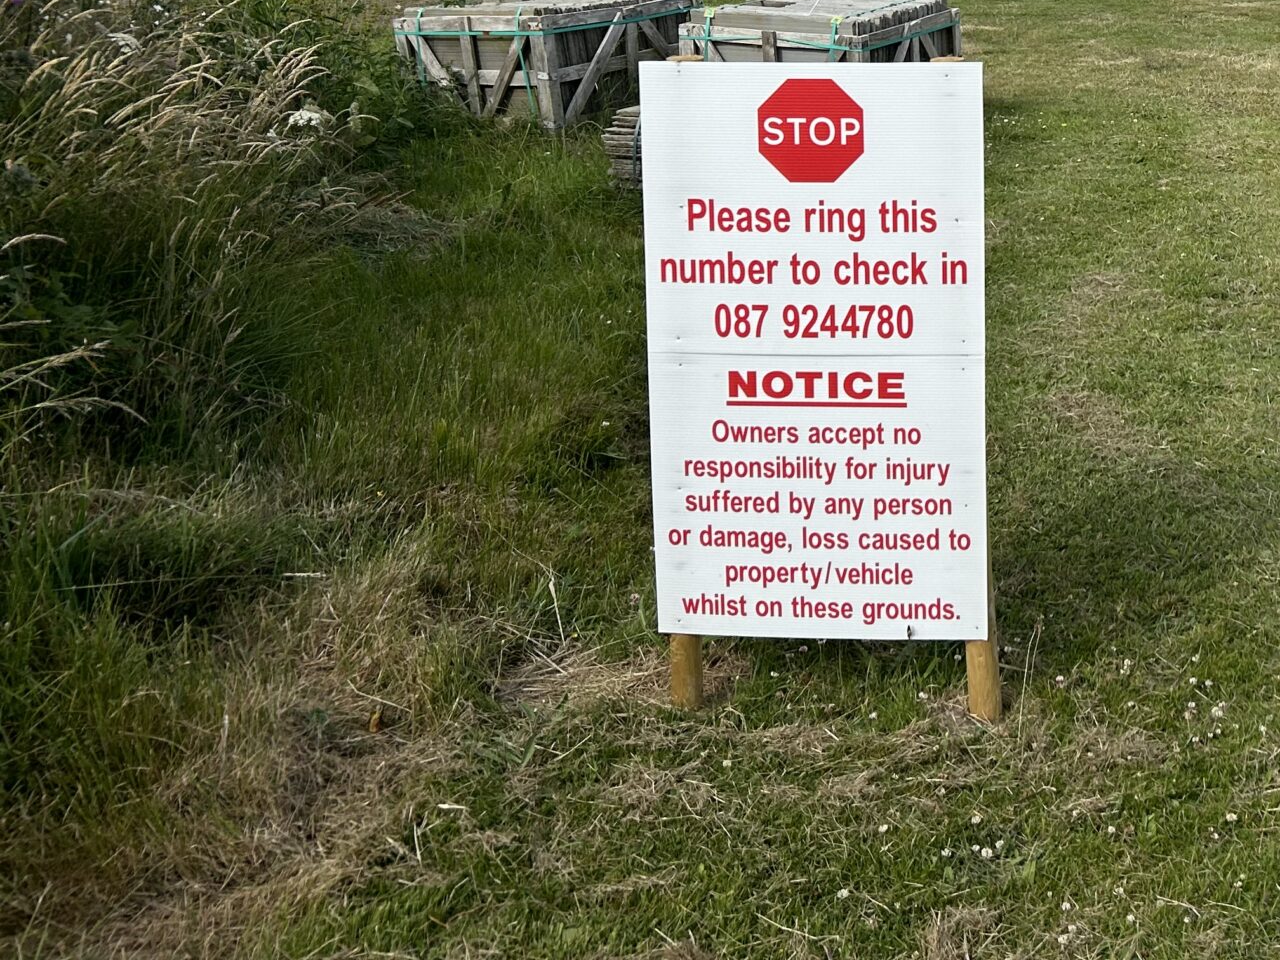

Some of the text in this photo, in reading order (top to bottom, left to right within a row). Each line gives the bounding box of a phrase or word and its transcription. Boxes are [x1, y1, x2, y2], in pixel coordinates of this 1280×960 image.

[763, 117, 861, 146] STOP
[687, 198, 938, 242] Please ring this
[659, 251, 968, 286] number to check in
[713, 303, 914, 340] 087 9244780
[727, 370, 906, 400] NOTICE
[711, 419, 922, 450] Owners accept no
[683, 456, 951, 487] responsibility for injury
[685, 490, 952, 521] suffered by any person
[668, 525, 972, 555] or damage, loss caused to
[682, 593, 961, 626] whilst on these grounds.
